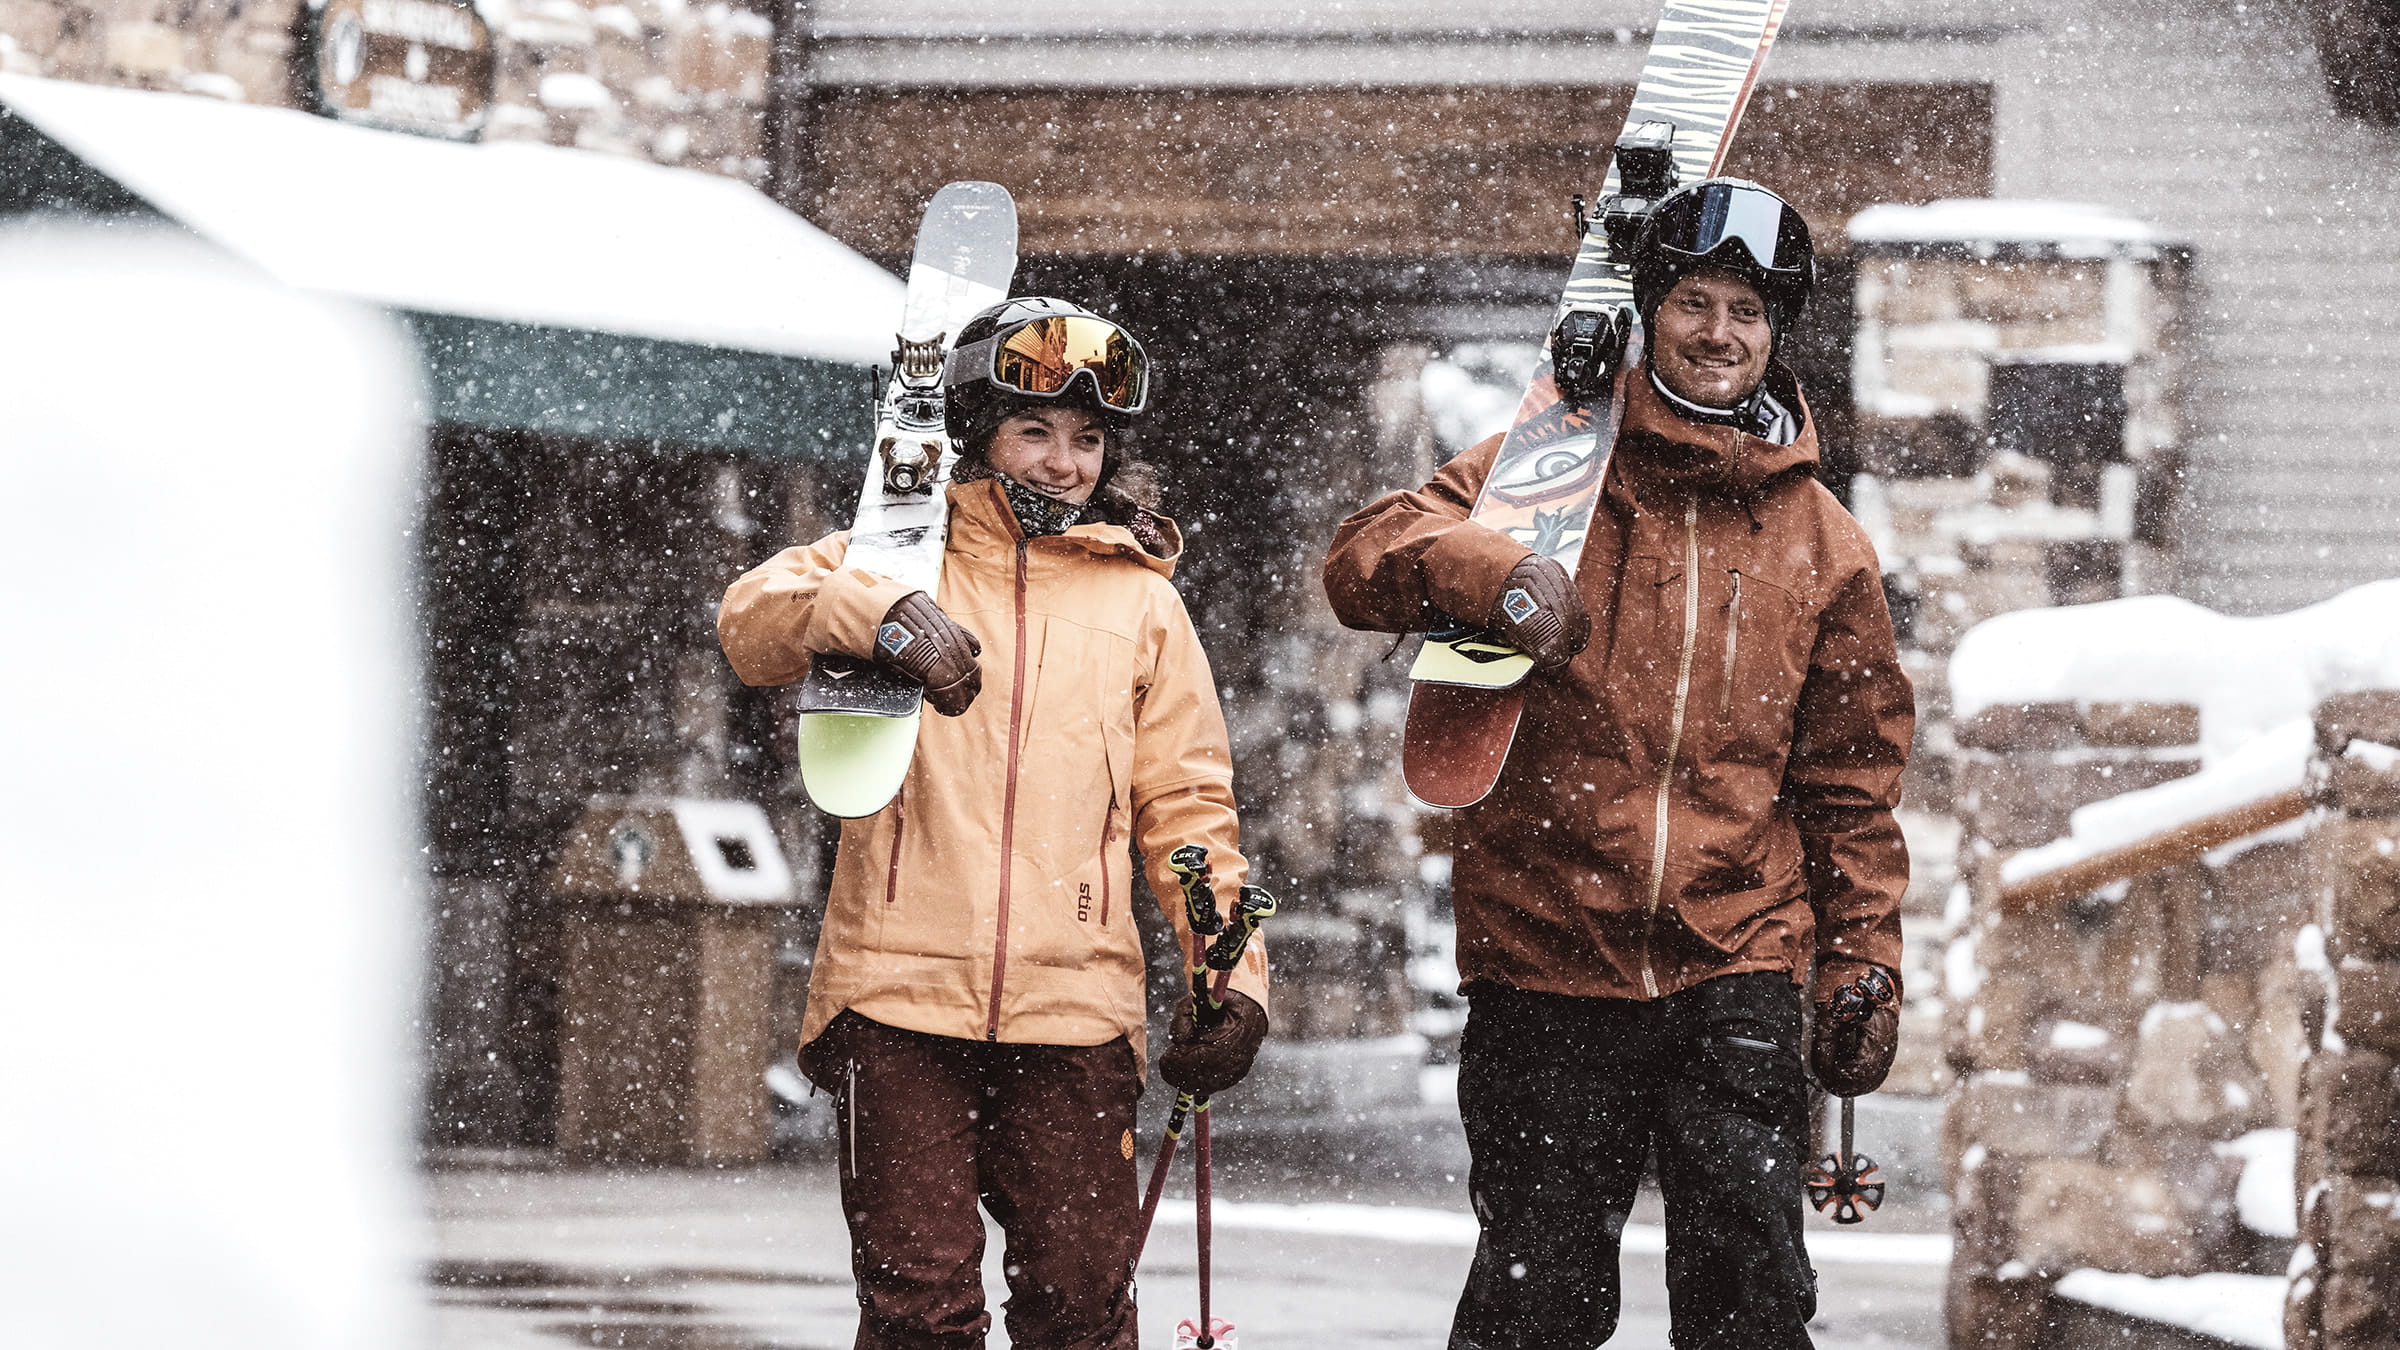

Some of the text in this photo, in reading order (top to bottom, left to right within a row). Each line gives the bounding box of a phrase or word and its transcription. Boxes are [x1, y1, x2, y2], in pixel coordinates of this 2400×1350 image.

[1172, 852, 1197, 861] LEKI
[1077, 882, 1092, 922] stio
[1250, 893, 1273, 905] LEKI
